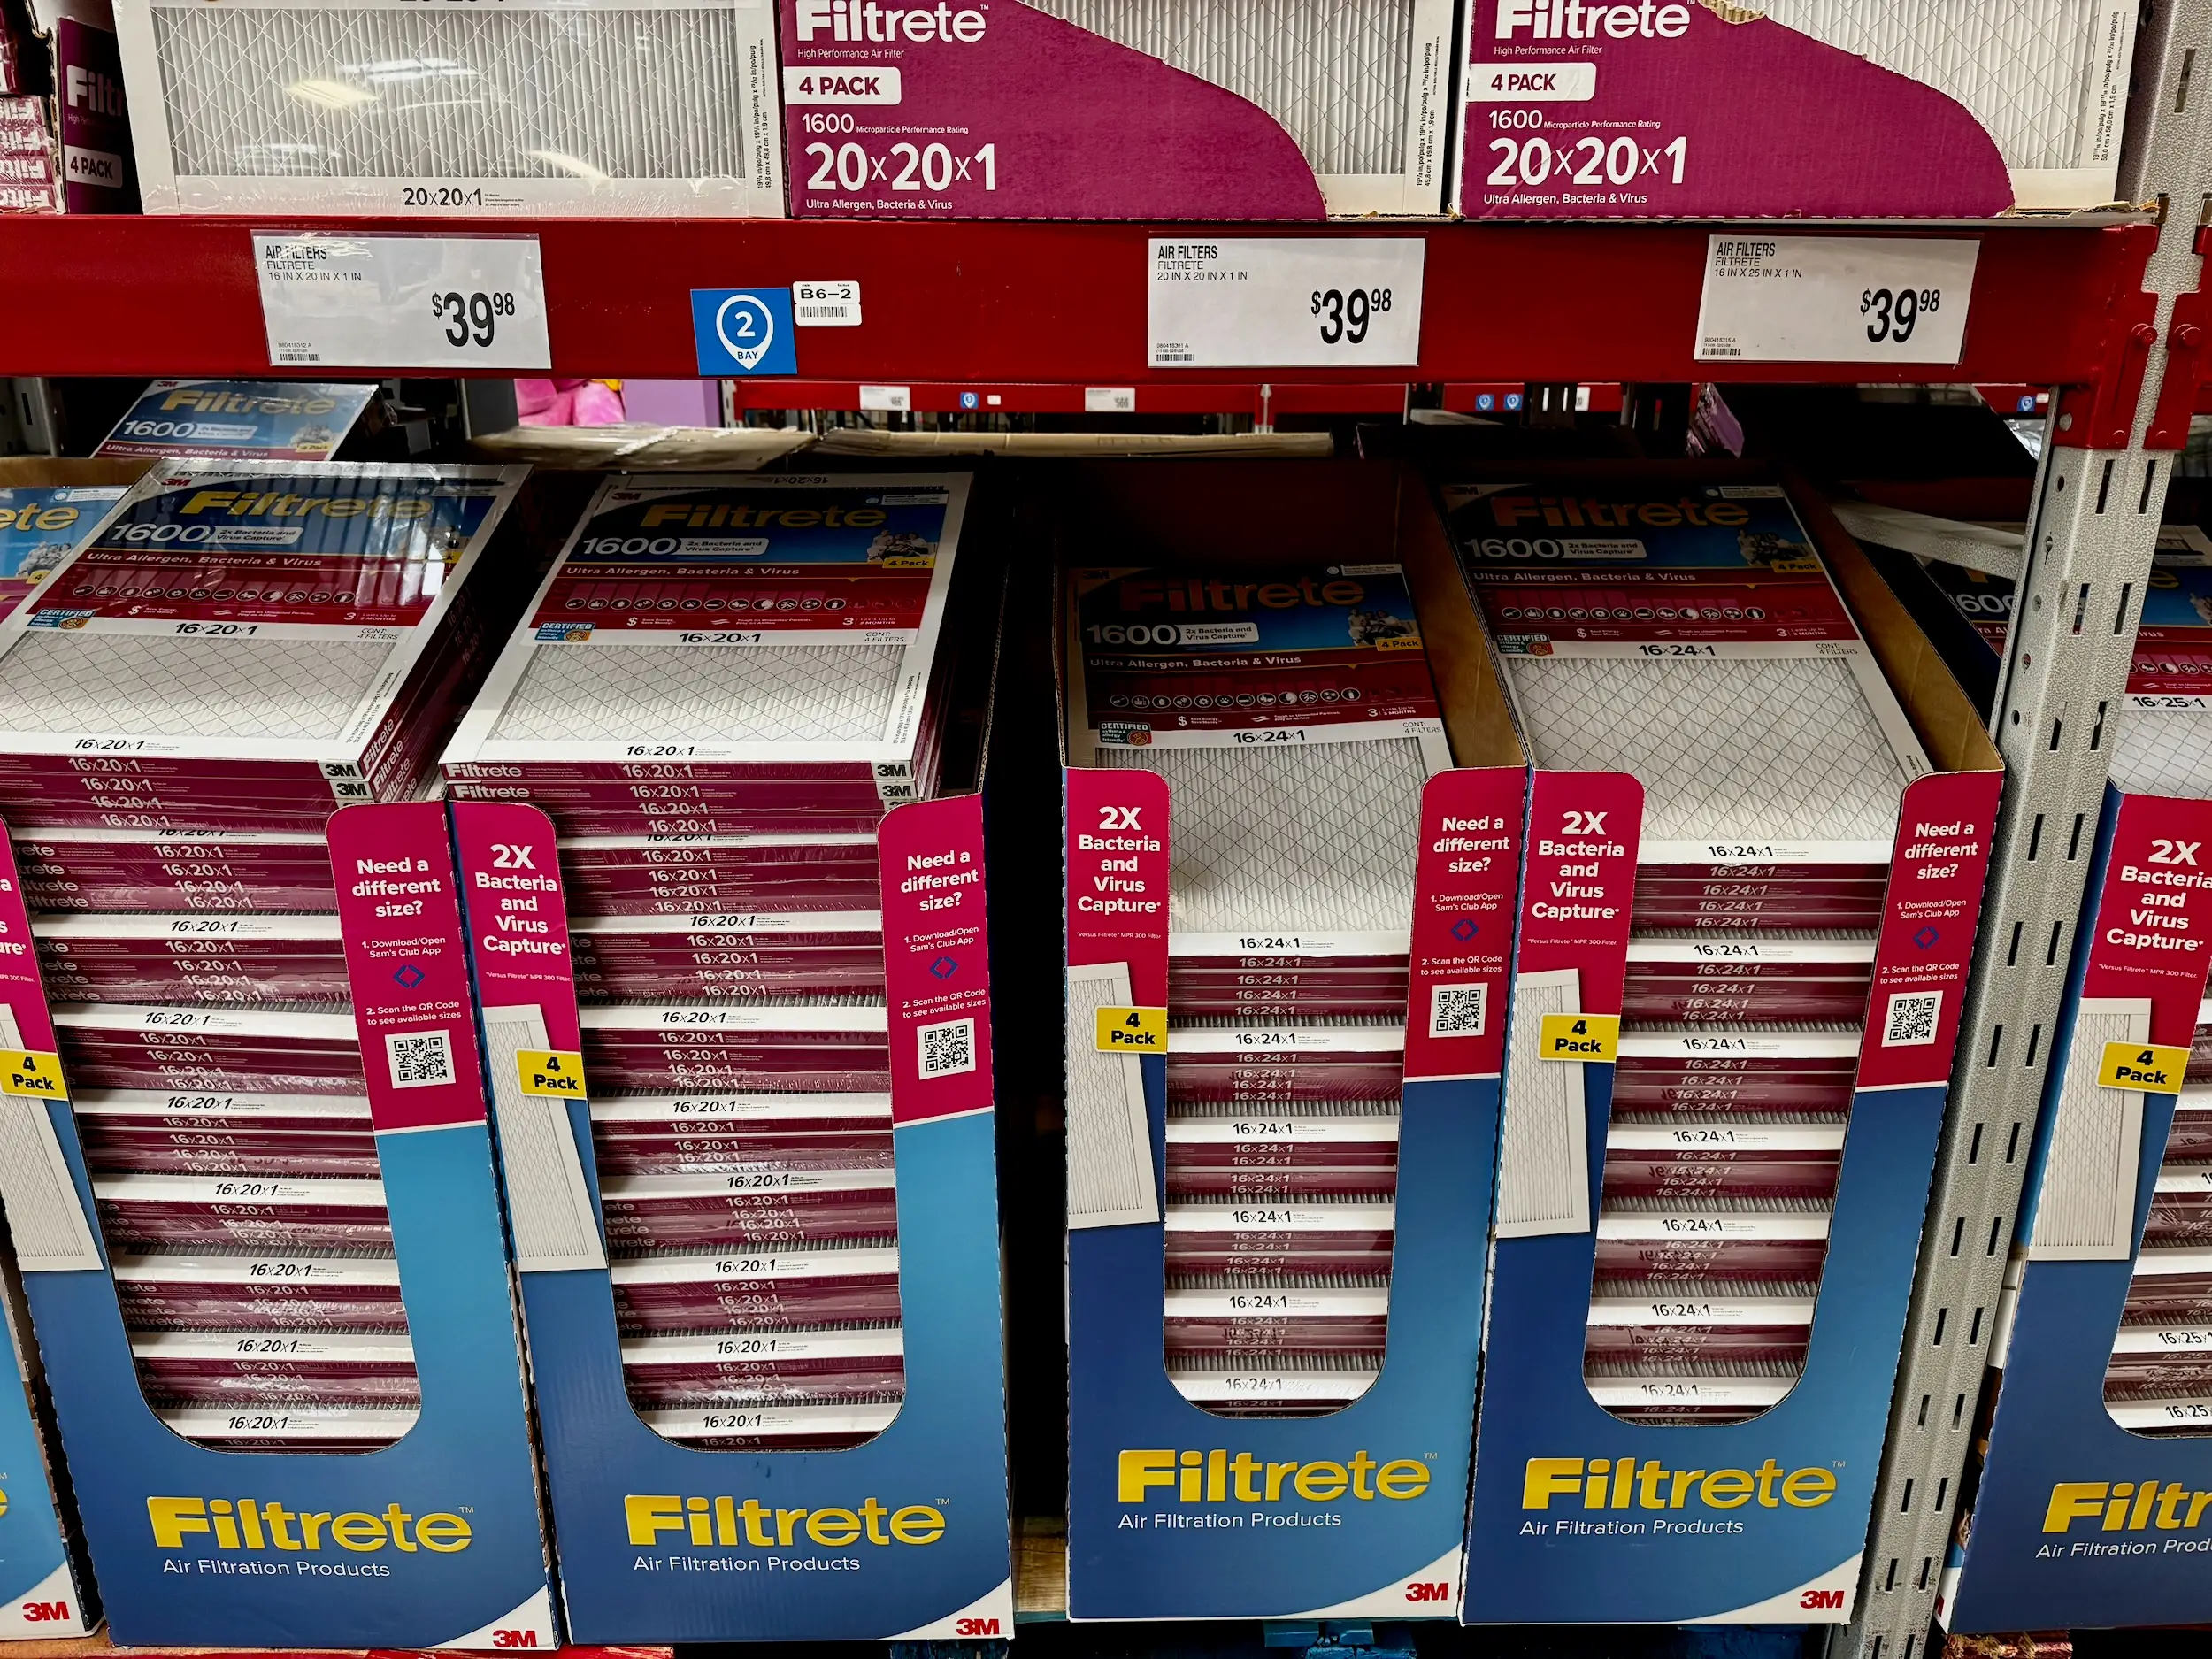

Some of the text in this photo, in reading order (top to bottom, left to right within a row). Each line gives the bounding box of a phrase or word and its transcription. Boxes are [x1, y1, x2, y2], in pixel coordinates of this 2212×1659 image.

[798, 49, 817, 59] High
[818, 49, 869, 58] Performance
[1494, 46, 1513, 56] High
[1515, 46, 1566, 55] Performance
[1582, 45, 1602, 54] Filter
[799, 77, 880, 96] 4 PACK
[1491, 73, 1556, 91] 4 PACK
[802, 113, 854, 133] 1600
[947, 126, 968, 134] Rating
[1489, 110, 1543, 129] 1600
[1544, 120, 1589, 129] Microparticle
[1638, 120, 1661, 129] Rating
[71, 157, 113, 178] 4 PACK
[806, 199, 952, 211] Ultra Allergen, Bacteria & Virus
[1484, 194, 1647, 205] Ultra Allergen, Bacteria & Virus
[1158, 246, 1217, 259] AIR FILTERS
[1717, 242, 1775, 257] AIR FILTERS
[267, 261, 315, 270] FILTRETE
[1157, 261, 1203, 270] FILTRETE
[1715, 257, 1760, 267] FILTRETE
[269, 272, 280, 280] 16
[283, 272, 293, 280] IN
[351, 273, 361, 281] IN
[1157, 272, 1169, 280] 20
[1171, 272, 1181, 280] IN
[1184, 272, 1191, 280] X
[1194, 272, 1205, 280] 20
[1715, 268, 1724, 277] 16
[1727, 268, 1737, 277] IN
[1775, 269, 1781, 278] X
[1792, 269, 1802, 278] IN
[801, 289, 851, 299] B6-2
[735, 311, 756, 337] 2
[737, 351, 758, 360] BAY
[641, 504, 886, 527] Filtrete
[582, 537, 676, 556] 1600
[1121, 577, 1364, 611] Filtrete
[1087, 624, 1177, 645] 1600
[445, 764, 522, 779] Filtrete
[877, 764, 906, 777] 3M
[1441, 817, 1504, 833] Need a
[1561, 811, 1608, 835] 2X
[1432, 836, 1510, 854] different
[1538, 840, 1624, 857] Bacteria
[490, 843, 536, 870] 2X
[357, 859, 429, 875] Need a
[1448, 857, 1492, 873] size?
[1559, 862, 1600, 878] and
[351, 877, 442, 897] different
[475, 872, 557, 893] Bacteria
[1550, 882, 1605, 899] Virus
[374, 901, 423, 918] size?
[501, 896, 538, 913] and
[494, 914, 549, 934] Virus
[371, 936, 446, 949] Download/Open
[369, 946, 442, 958] Sam's Club App
[365, 1001, 460, 1016] 2. Scan the QR Code
[367, 1017, 376, 1025] to
[396, 1013, 436, 1024] available
[439, 1011, 461, 1021] sizes
[1125, 1012, 1140, 1028] 4
[1110, 1030, 1156, 1046] Pack
[546, 1056, 561, 1072] 4
[534, 1073, 579, 1091] Pack
[2036, 1539, 2160, 1559] Air Filtration
[163, 1558, 390, 1578] Air Filtration Products
[634, 1556, 860, 1571] Air Filtration Products
[1405, 1583, 1448, 1601] 3M
[1800, 1591, 1844, 1609] 3M
[22, 1603, 70, 1622] 3M
[956, 1618, 1000, 1636] 3M
[492, 1630, 536, 1647] 3M
